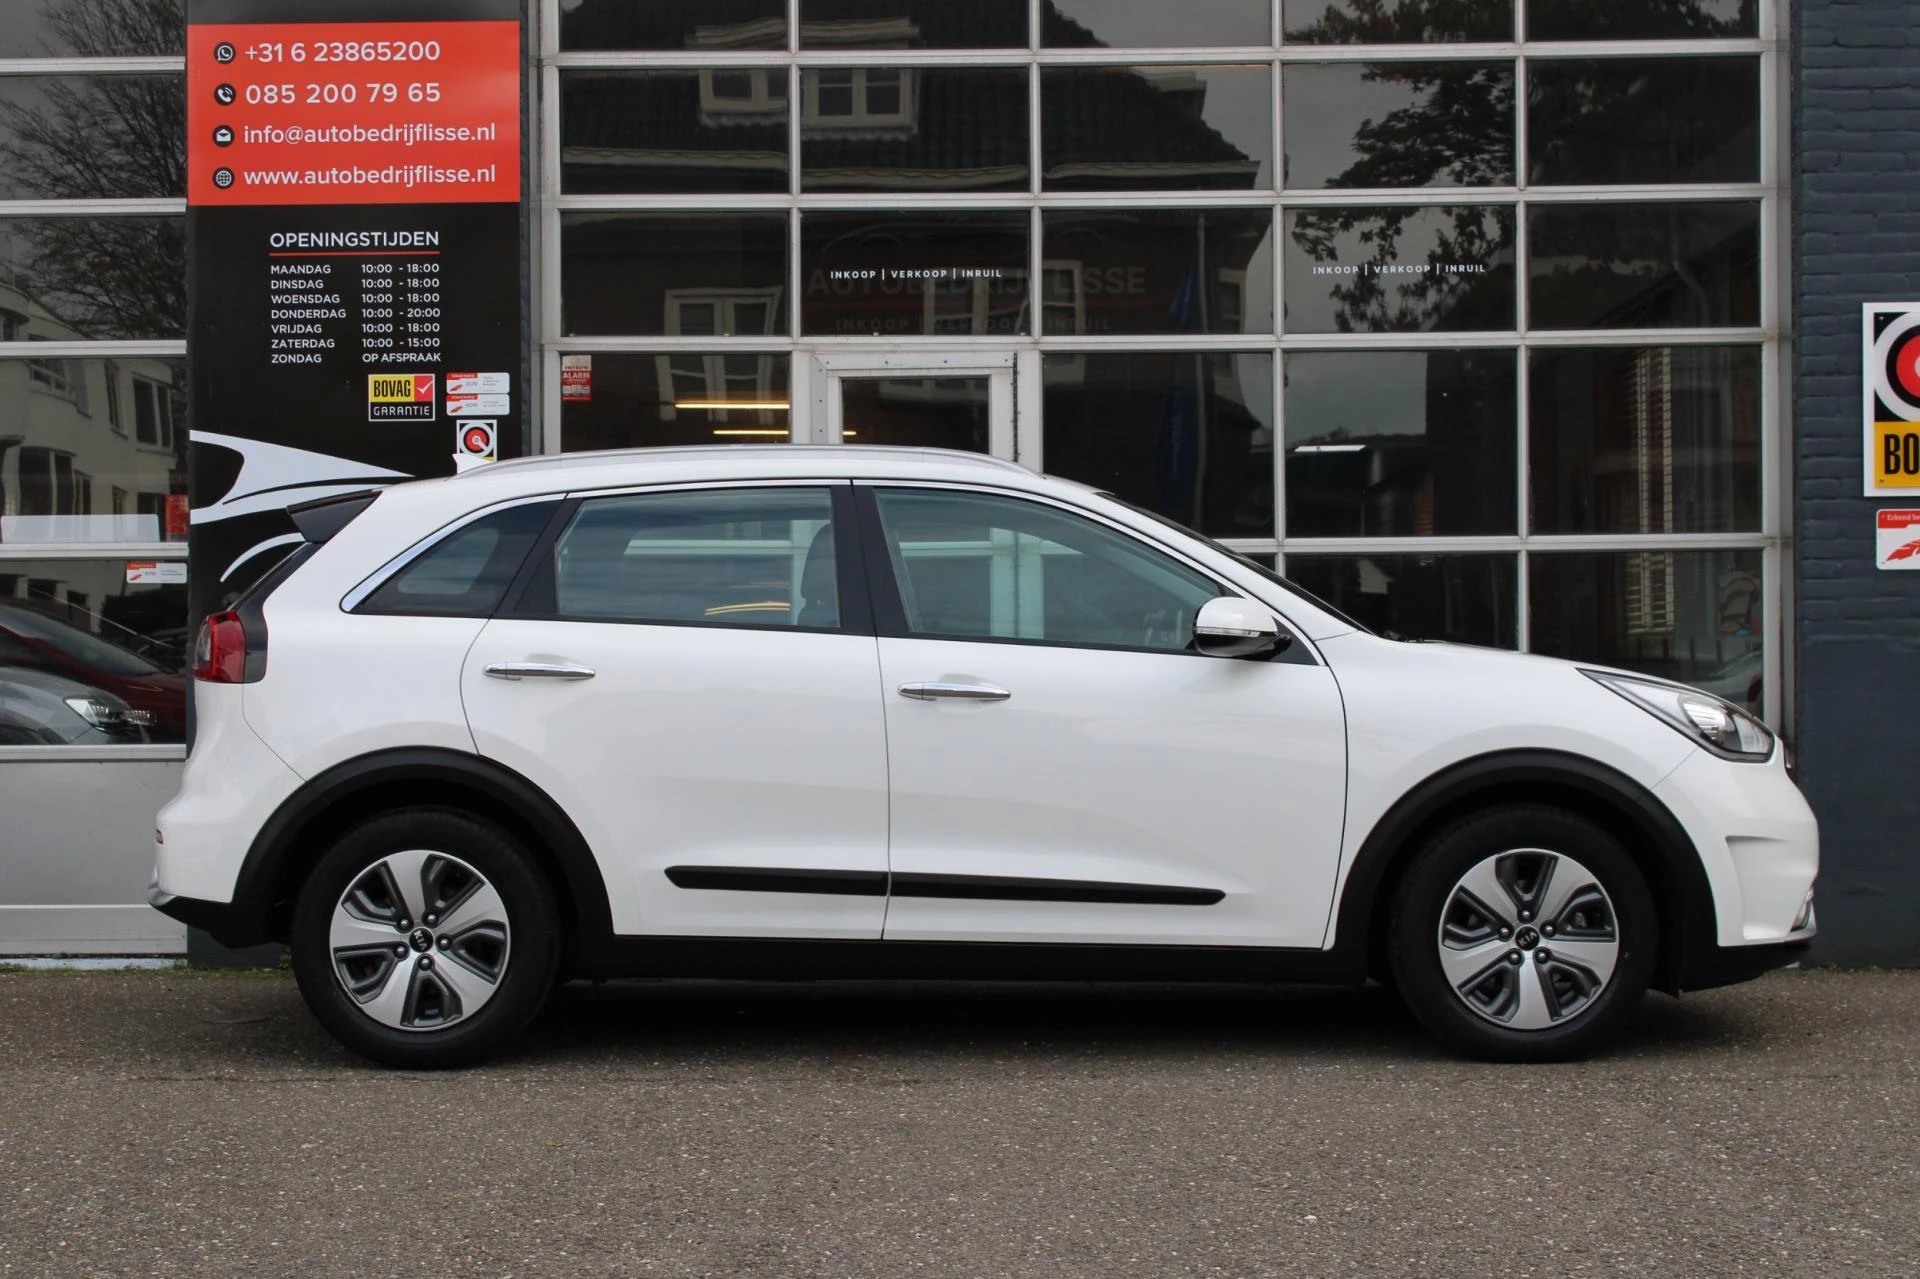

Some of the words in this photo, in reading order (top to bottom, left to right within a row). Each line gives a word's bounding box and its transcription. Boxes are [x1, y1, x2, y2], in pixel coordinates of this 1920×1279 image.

[246, 43, 282, 62] +31
[291, 43, 306, 62] 6
[314, 41, 440, 61] 23865200
[246, 85, 295, 104] 085
[307, 84, 356, 103] 200
[367, 83, 397, 102] 79
[408, 83, 440, 102] 65
[245, 123, 495, 145] info@autobedrijflisse.nl
[244, 165, 495, 187] www.autobedrijflisse.nl
[270, 232, 438, 247] OPENINGSTIJDEN
[271, 265, 331, 274] MAANDAG
[362, 264, 392, 273] 10:00
[407, 264, 439, 273] 18:00
[830, 270, 876, 279] INKOOP
[890, 269, 947, 279] VERKOOP
[961, 269, 1002, 278] INRUIL
[1313, 266, 1358, 274] INKOOP
[1374, 264, 1430, 274] VERKOOP
[1445, 264, 1485, 273] INRUIL
[271, 280, 323, 289] DINSDAG
[362, 279, 392, 288] 10:00
[407, 279, 439, 288] 18:00
[271, 295, 339, 303] WOENSDAG
[362, 294, 392, 303] 10:00
[407, 293, 439, 302] 18:00
[272, 309, 346, 318] DONDERDAG
[362, 309, 392, 317] 10:00
[407, 308, 440, 317] 20:00
[272, 324, 321, 333] VRIJDAG
[362, 324, 392, 332] 10:00
[407, 323, 439, 332] 18:00
[272, 339, 335, 348] ZATERDAG
[363, 338, 393, 347] 10:00
[407, 338, 440, 347] 15:00
[272, 354, 321, 363] ZONDAG
[363, 354, 378, 362] OP
[381, 353, 441, 362] AFSPRAAK
[563, 371, 590, 379] ALARM
[374, 380, 410, 397] BOVAG
[374, 406, 429, 415] GARANTIE
[1884, 433, 1919, 475] BO
[1518, 931, 1537, 947] KIA
